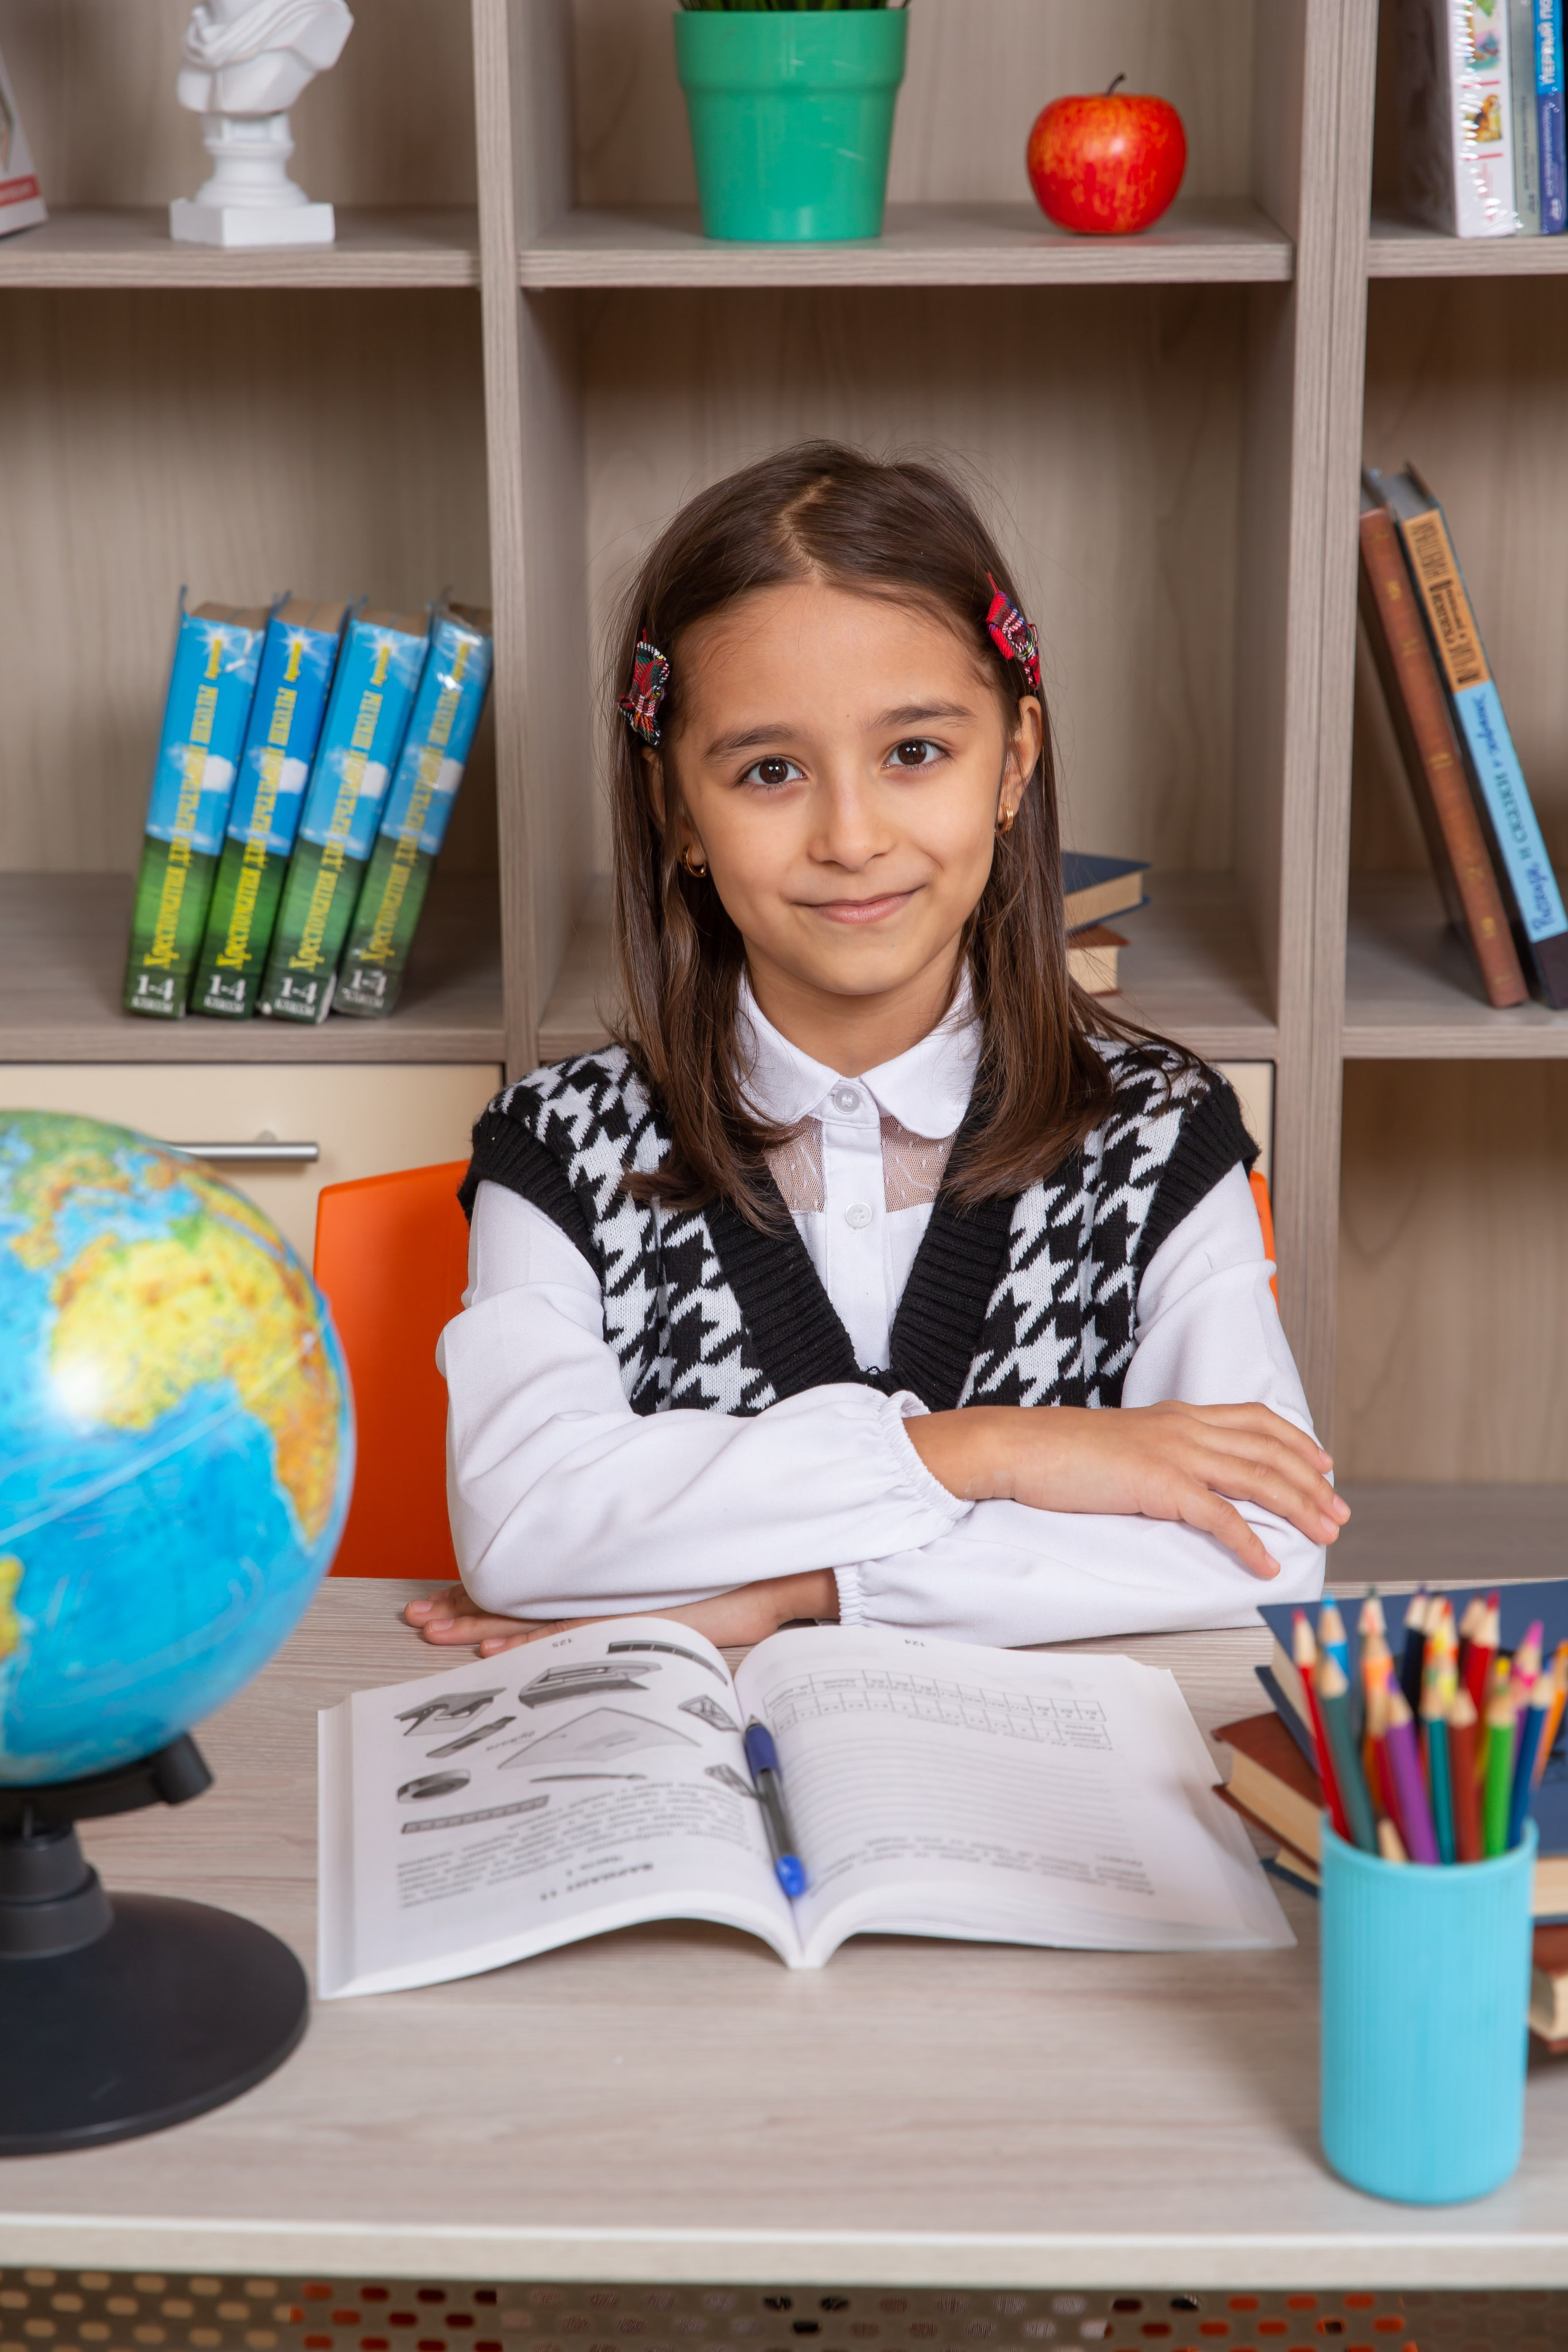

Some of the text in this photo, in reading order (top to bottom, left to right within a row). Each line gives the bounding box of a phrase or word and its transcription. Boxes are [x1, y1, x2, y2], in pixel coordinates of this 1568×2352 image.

[189, 684, 219, 744] школы
[267, 686, 298, 747] школы
[350, 690, 383, 750] школы
[174, 744, 208, 832] начальной
[249, 745, 285, 834] начальной
[329, 748, 369, 837] начальной
[168, 835, 195, 868] для
[243, 836, 270, 870] для
[320, 839, 347, 872] для
[143, 865, 187, 970] Хрестоматия
[216, 866, 262, 971] Хрестоматия
[288, 869, 339, 974] Хрестоматия
[360, 863, 412, 967] Хрестоматия
[394, 834, 421, 867] для
[137, 974, 175, 1001] 1-4
[209, 974, 247, 1001] 1-4
[279, 977, 318, 1005] 1-4
[551, 1638, 573, 1648] 125
